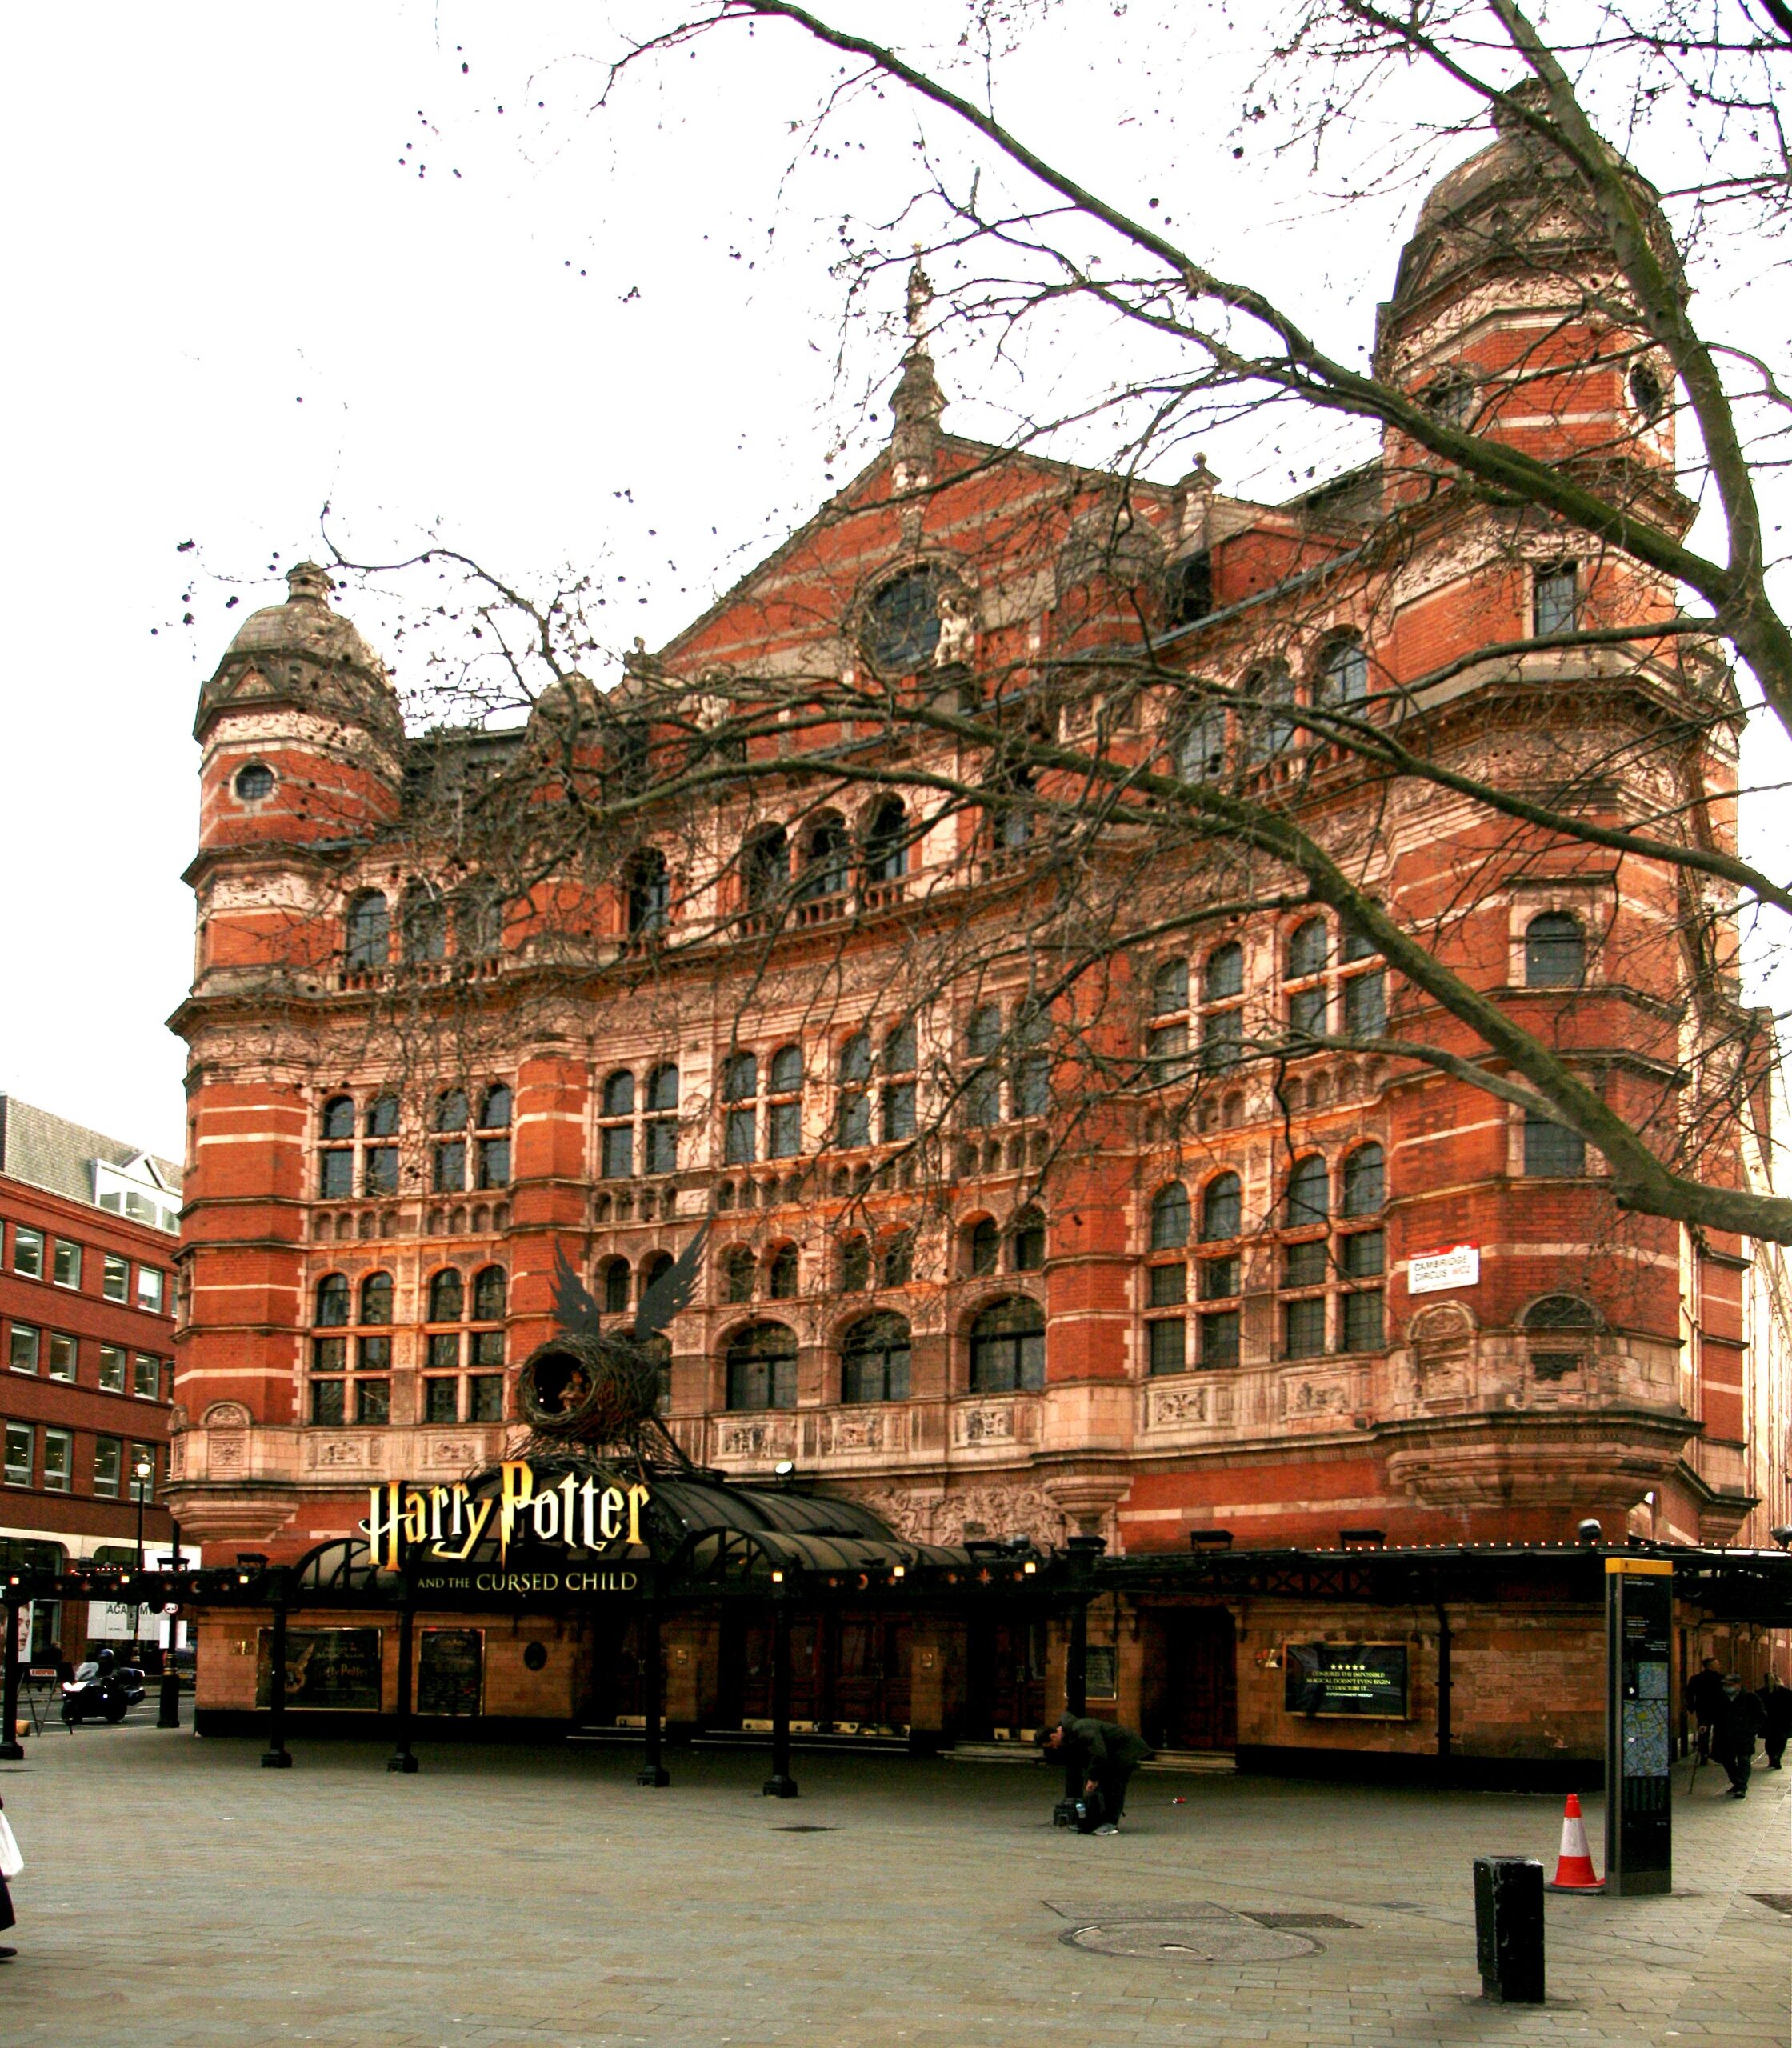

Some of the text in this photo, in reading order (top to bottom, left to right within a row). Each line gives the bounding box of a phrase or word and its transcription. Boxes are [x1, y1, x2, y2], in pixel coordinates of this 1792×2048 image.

[1414, 1255, 1467, 1271] CAMBRIDGE
[1414, 1269, 1447, 1282] CIRCUS
[358, 1460, 650, 1572] Harry Potter
[417, 1571, 638, 1593] AND THE CURSED CHILD
